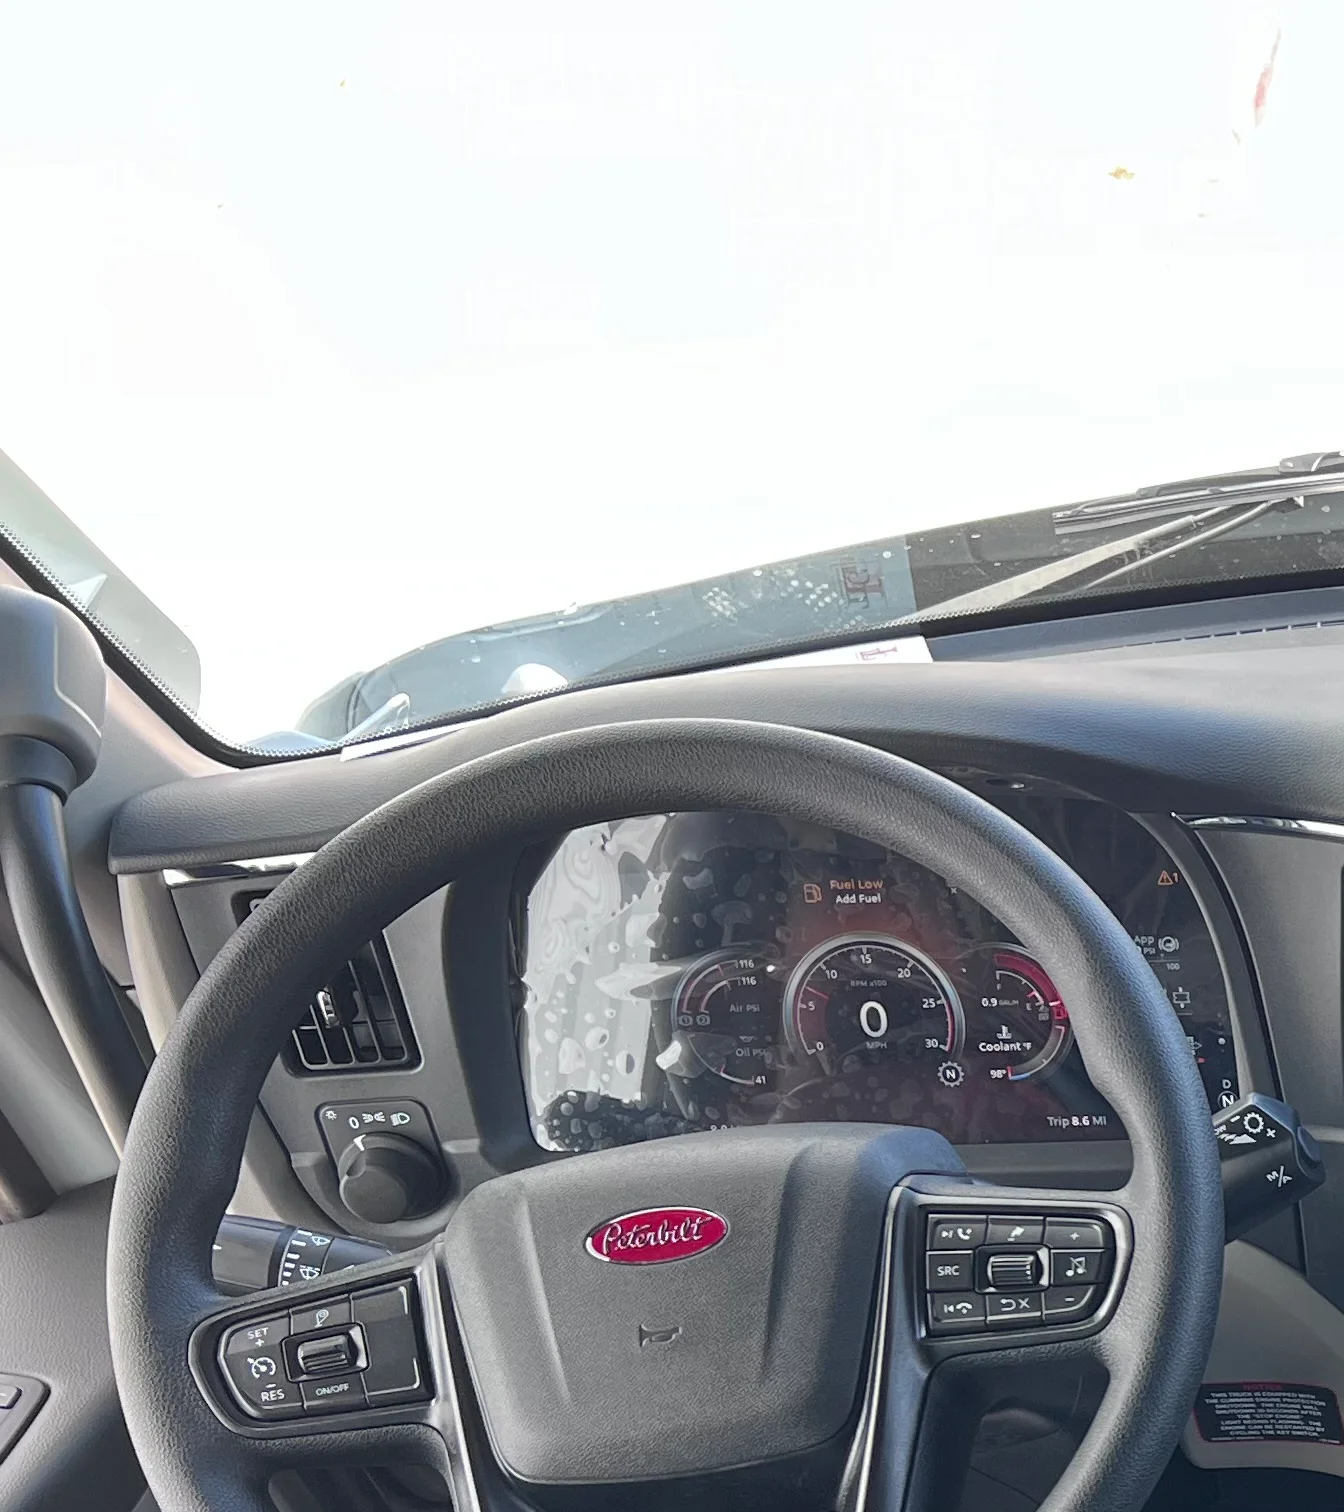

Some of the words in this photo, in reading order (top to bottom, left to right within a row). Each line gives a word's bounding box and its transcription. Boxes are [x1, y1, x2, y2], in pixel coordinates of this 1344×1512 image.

[829, 880, 855, 890] Fuel
[858, 880, 883, 890] Low
[835, 894, 857, 904] Add
[858, 894, 882, 904] Fuel
[739, 959, 755, 969] 116
[860, 954, 872, 965] 15
[825, 969, 838, 980] 10
[897, 968, 912, 979] 20
[741, 976, 757, 986] 116
[729, 1003, 744, 1013] Air
[745, 1003, 761, 1013] PSI
[808, 1001, 816, 1011] 5
[922, 998, 937, 1009] 25
[981, 998, 998, 1007] 0.9
[859, 1000, 888, 1038] 0
[815, 1042, 824, 1052] 0
[865, 1041, 888, 1050] MPH
[925, 1039, 939, 1049] 30
[978, 1041, 1021, 1052] Coolant
[735, 1048, 750, 1057] Oil
[755, 1075, 767, 1085] 41
[945, 1069, 956, 1080] N
[1222, 1079, 1232, 1089] D
[1221, 1094, 1234, 1108] N
[1047, 1116, 1070, 1129] Trip
[1071, 1116, 1091, 1127] 8.6
[1092, 1116, 1108, 1127] MI
[602, 1214, 713, 1256] Peterbilt
[937, 1263, 961, 1278] SRC
[247, 1326, 269, 1340] SET
[260, 1388, 285, 1402] RES
[315, 1382, 350, 1397] ON/OFF
